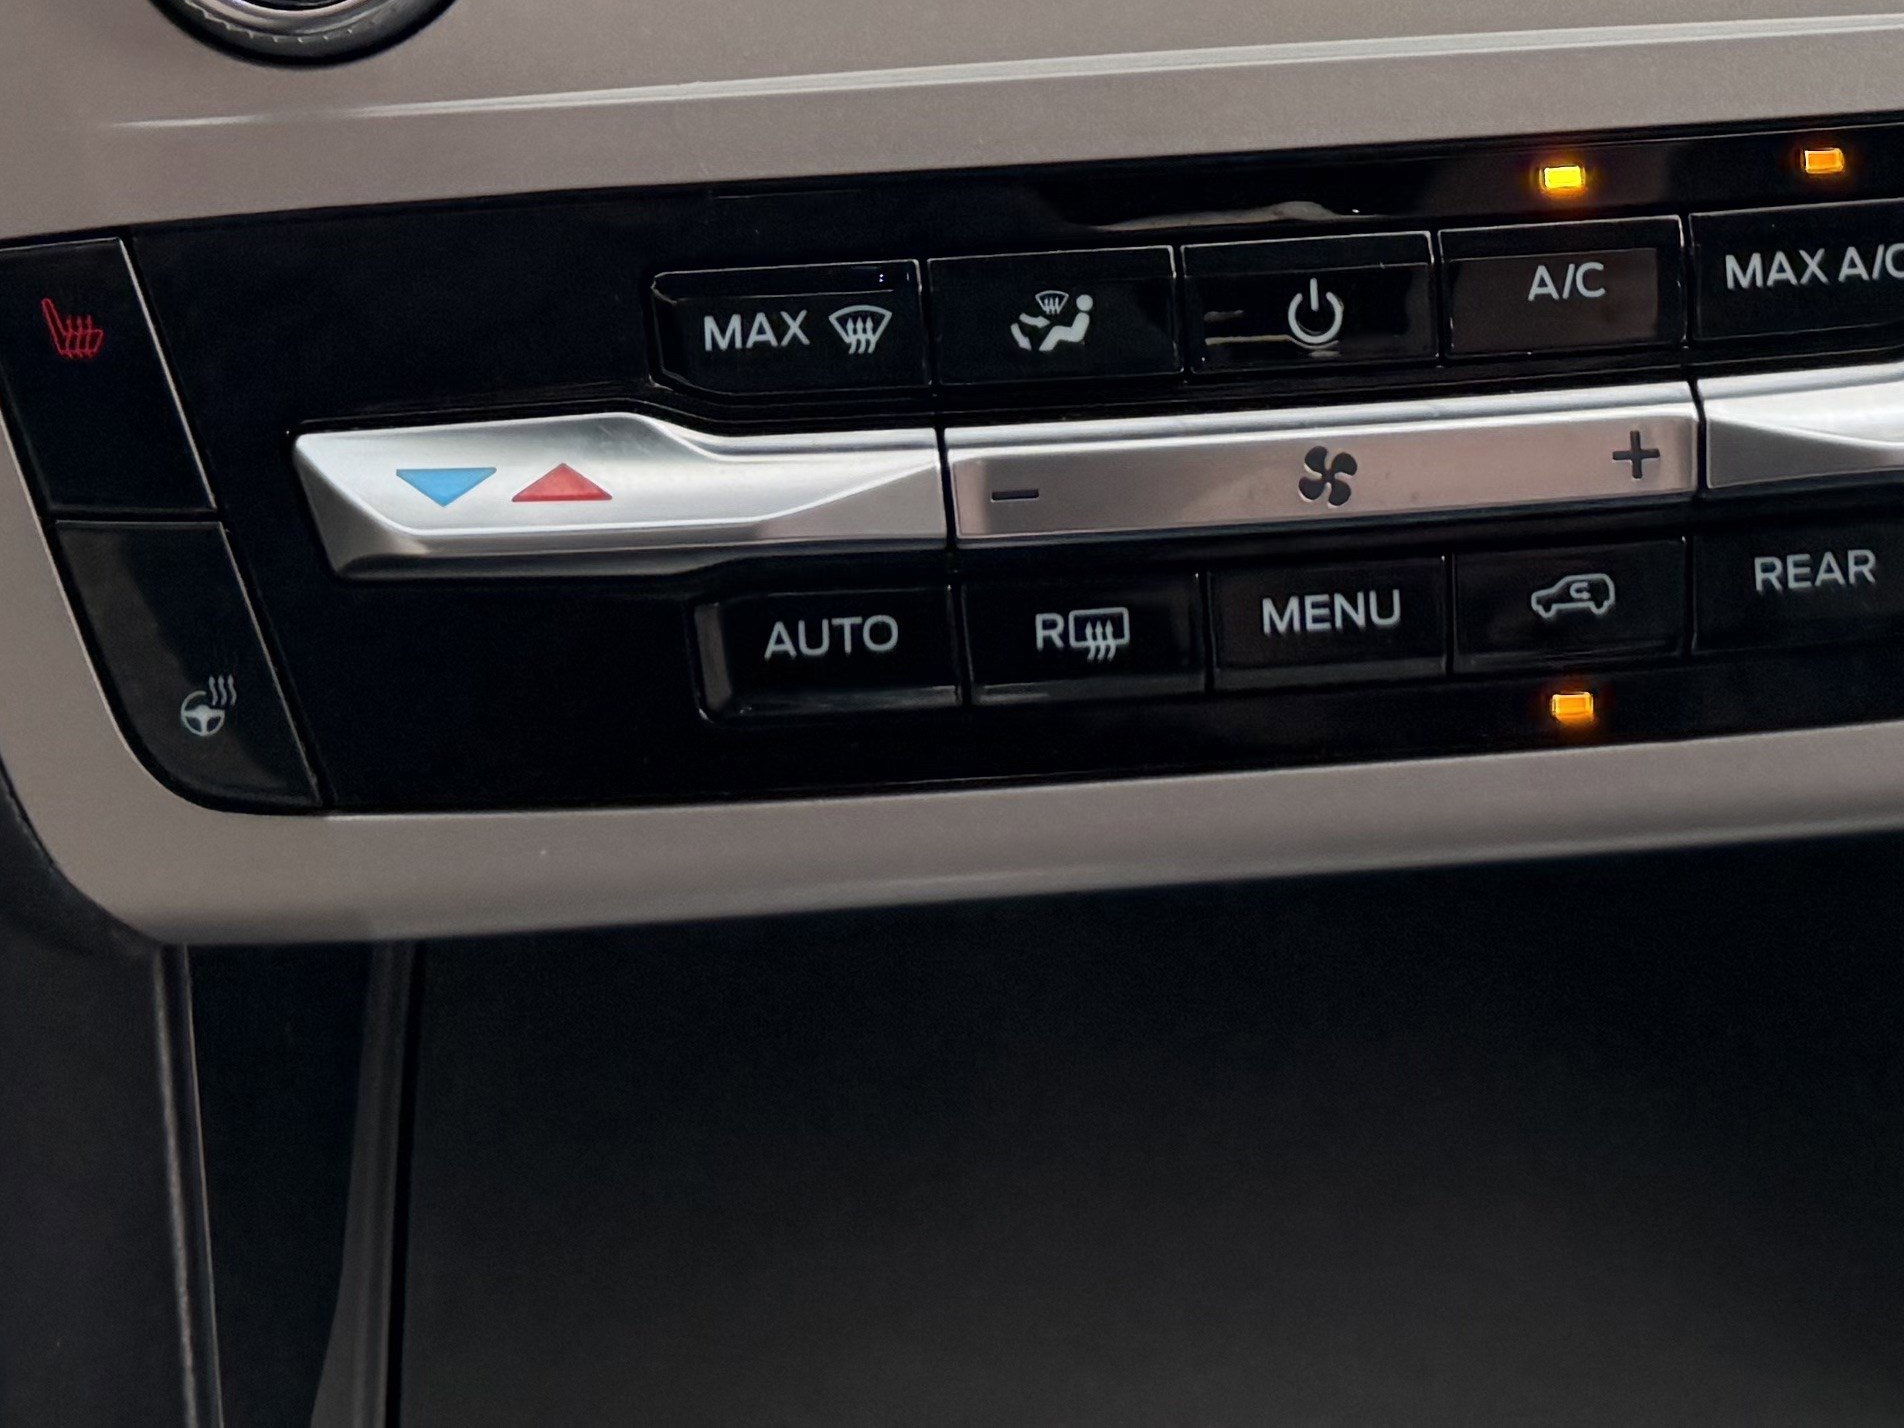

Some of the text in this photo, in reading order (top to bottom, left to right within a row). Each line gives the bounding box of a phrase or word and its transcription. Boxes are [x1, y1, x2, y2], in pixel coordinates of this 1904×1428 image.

[1527, 261, 1606, 301] A/C
[1725, 248, 1828, 289] MAX
[703, 310, 810, 351] MAX
[1754, 549, 1876, 592] REAR
[1035, 612, 1065, 650] R
[1262, 589, 1401, 635] MENU
[764, 614, 899, 659] AUTO
